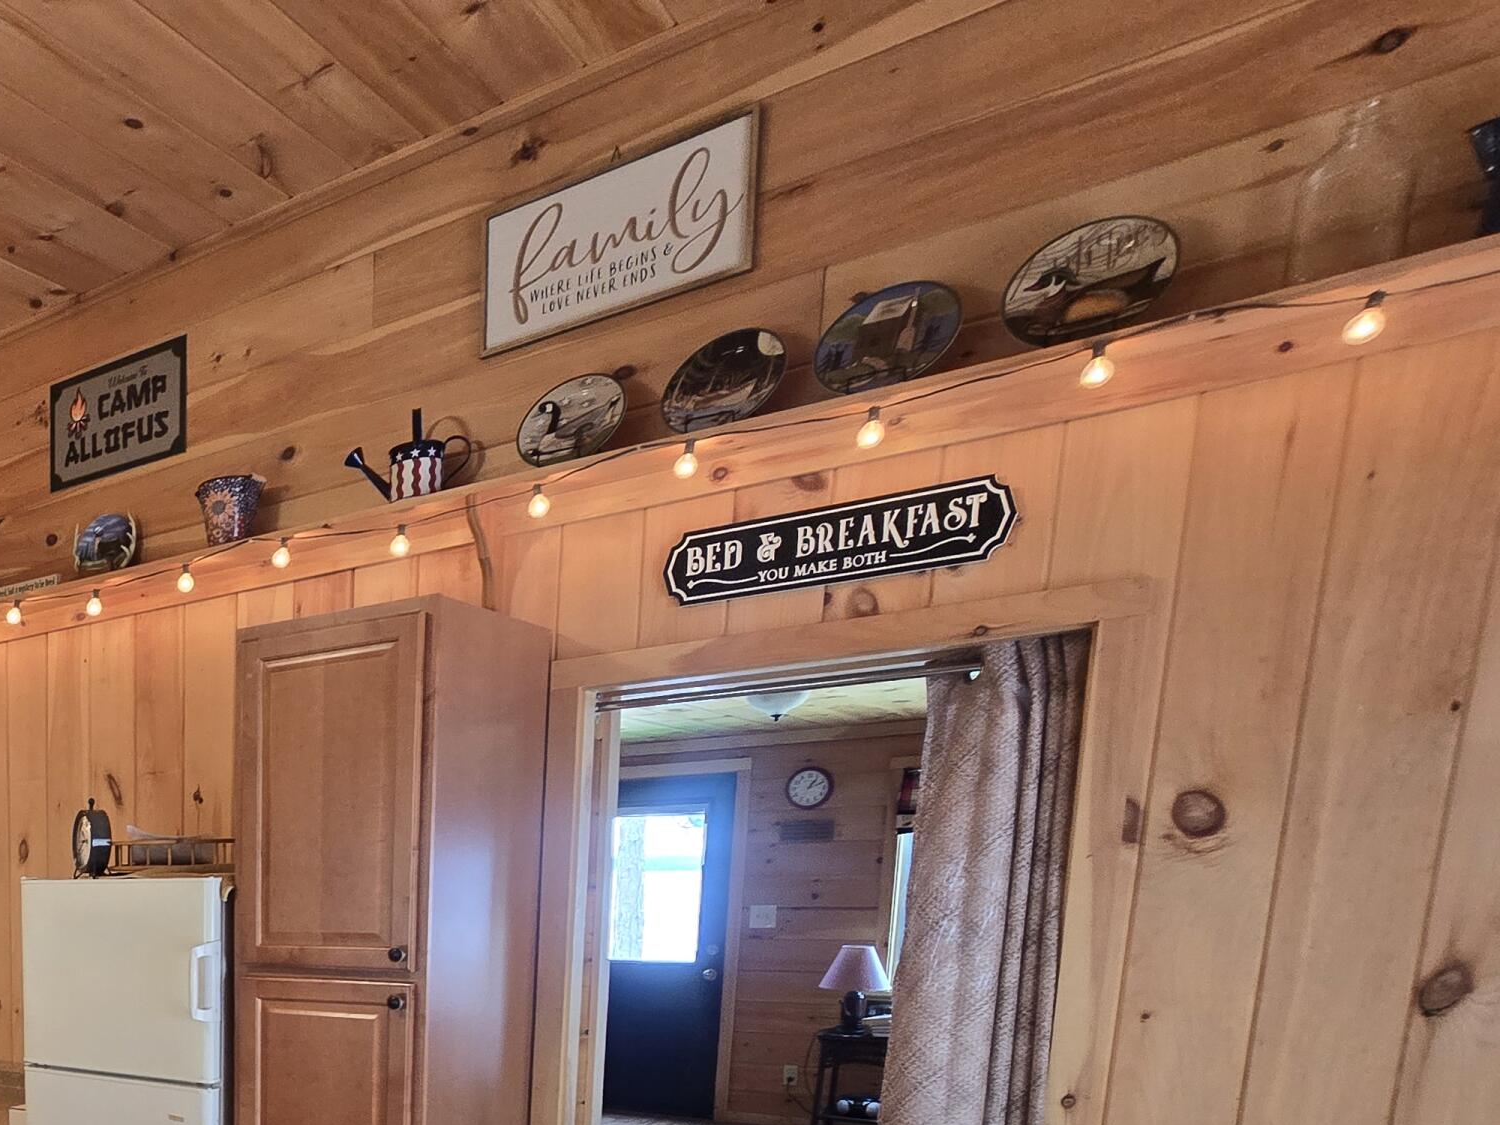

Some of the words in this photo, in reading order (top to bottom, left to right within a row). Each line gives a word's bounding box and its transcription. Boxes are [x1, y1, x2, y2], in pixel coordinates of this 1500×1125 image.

[508, 147, 744, 324] family
[530, 279, 571, 303] WHERE
[663, 242, 674, 256] &
[542, 295, 571, 315] LOVE
[576, 278, 618, 304] NEVER
[623, 263, 656, 287] ENDS
[97, 374, 167, 421] CAMP
[686, 539, 742, 577] BED
[756, 531, 782, 562] &
[795, 492, 988, 559] BREAKFAST
[757, 566, 789, 583] YOU
[794, 561, 838, 578] MAKE
[843, 550, 887, 571] BOTH
